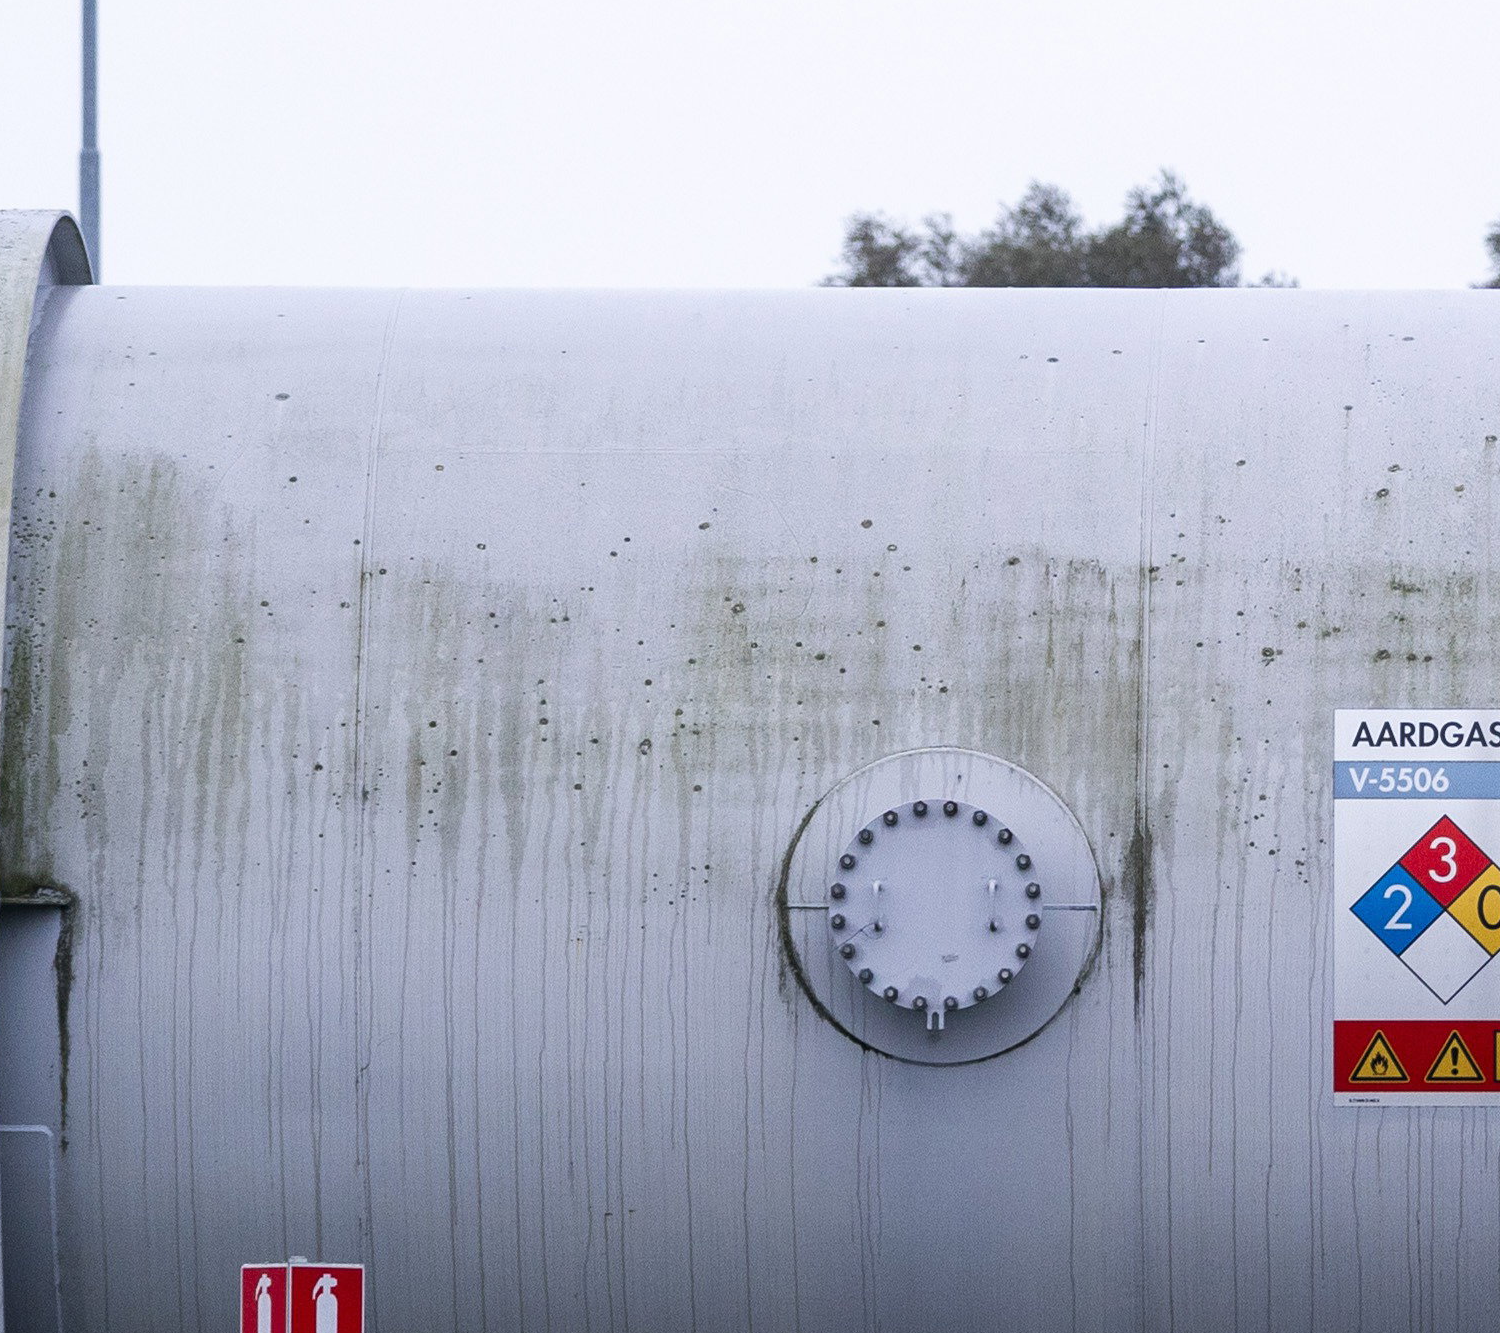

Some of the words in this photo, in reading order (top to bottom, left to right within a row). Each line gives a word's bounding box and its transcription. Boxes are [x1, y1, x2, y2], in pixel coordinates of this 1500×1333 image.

[1350, 767, 1450, 793] V-5506
[1428, 836, 1458, 883] 3
[1383, 884, 1413, 931] 2
